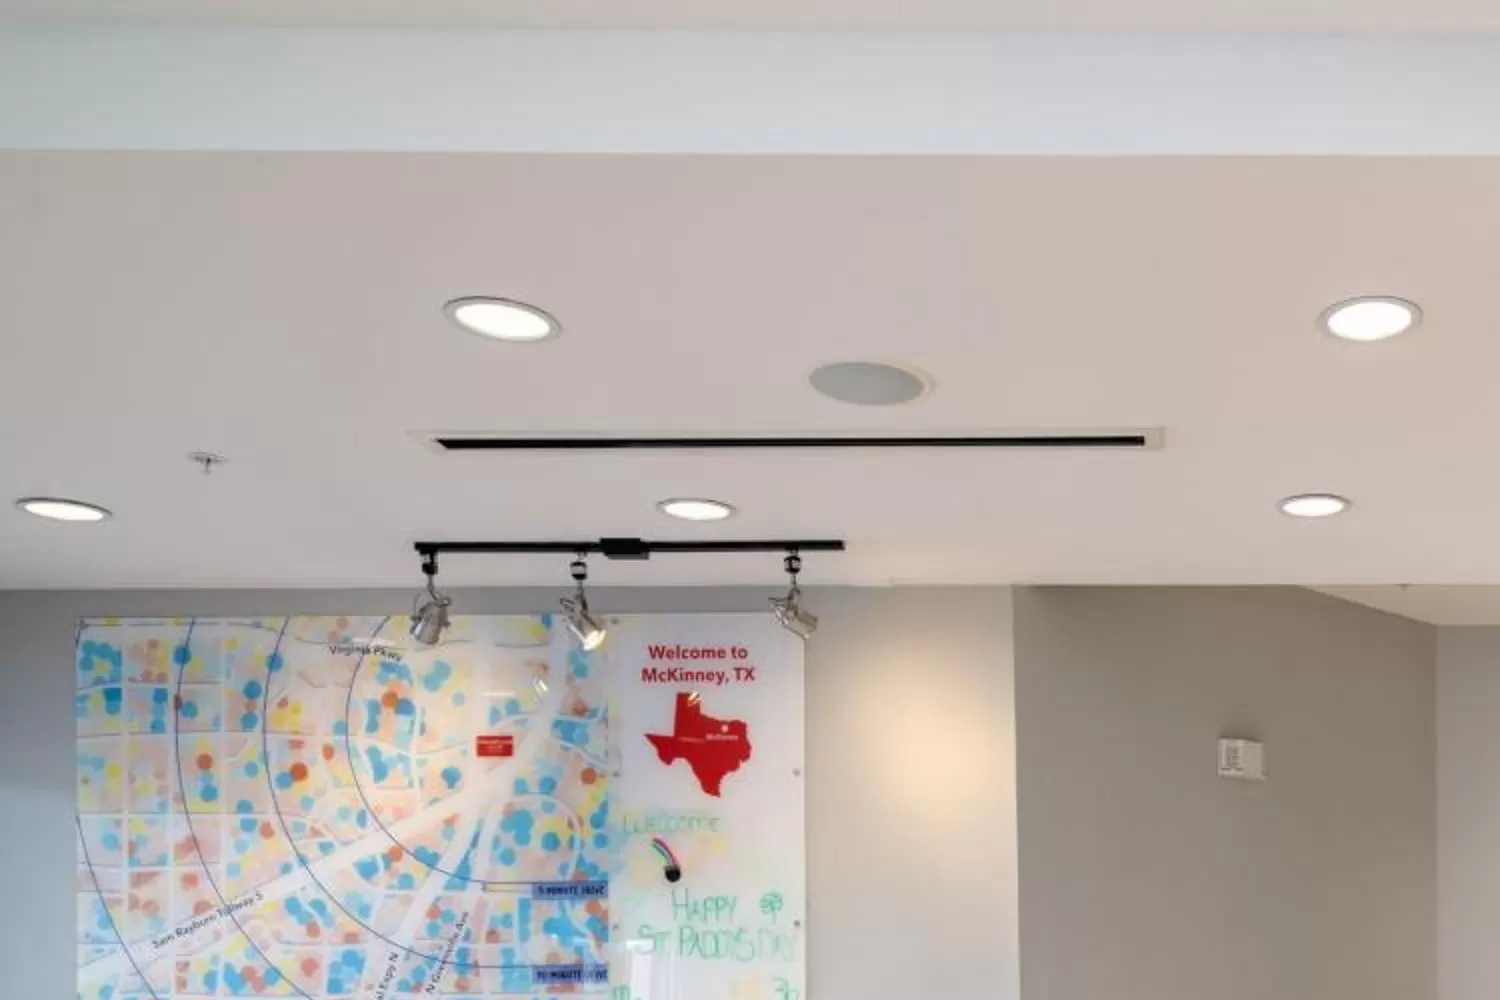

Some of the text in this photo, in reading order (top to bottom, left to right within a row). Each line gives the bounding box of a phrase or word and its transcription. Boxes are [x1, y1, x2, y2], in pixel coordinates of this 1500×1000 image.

[648, 645, 749, 660] Welcome to
[641, 667, 756, 686] McKinney, TX
[151, 934, 175, 949] Sam
[175, 914, 216, 937] Rayburn
